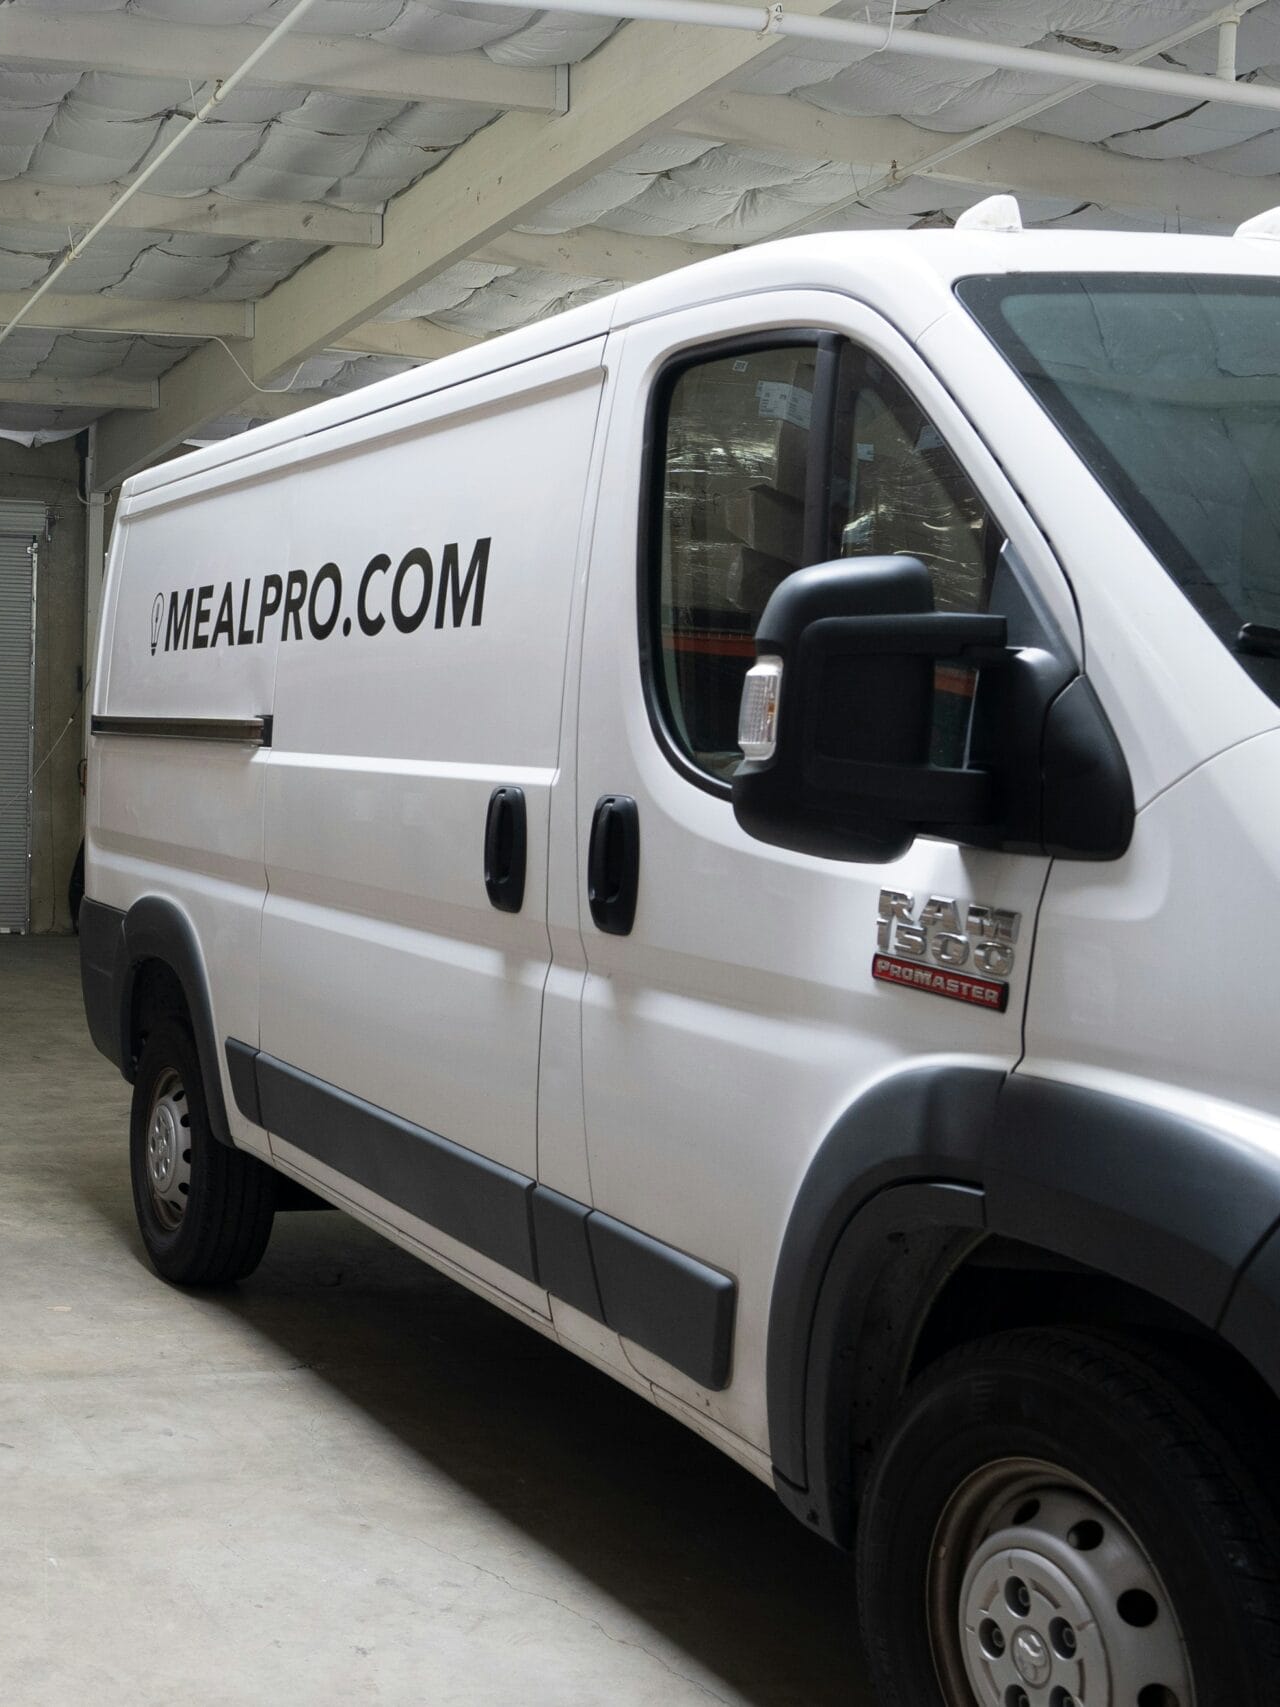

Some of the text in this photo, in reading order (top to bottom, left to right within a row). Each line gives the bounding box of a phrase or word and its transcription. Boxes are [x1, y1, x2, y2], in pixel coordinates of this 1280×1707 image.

[164, 536, 492, 652] MEALPRO.COM
[878, 887, 1022, 944] RAM
[876, 917, 1016, 977] 1500
[877, 958, 999, 1003] PROMASTER
